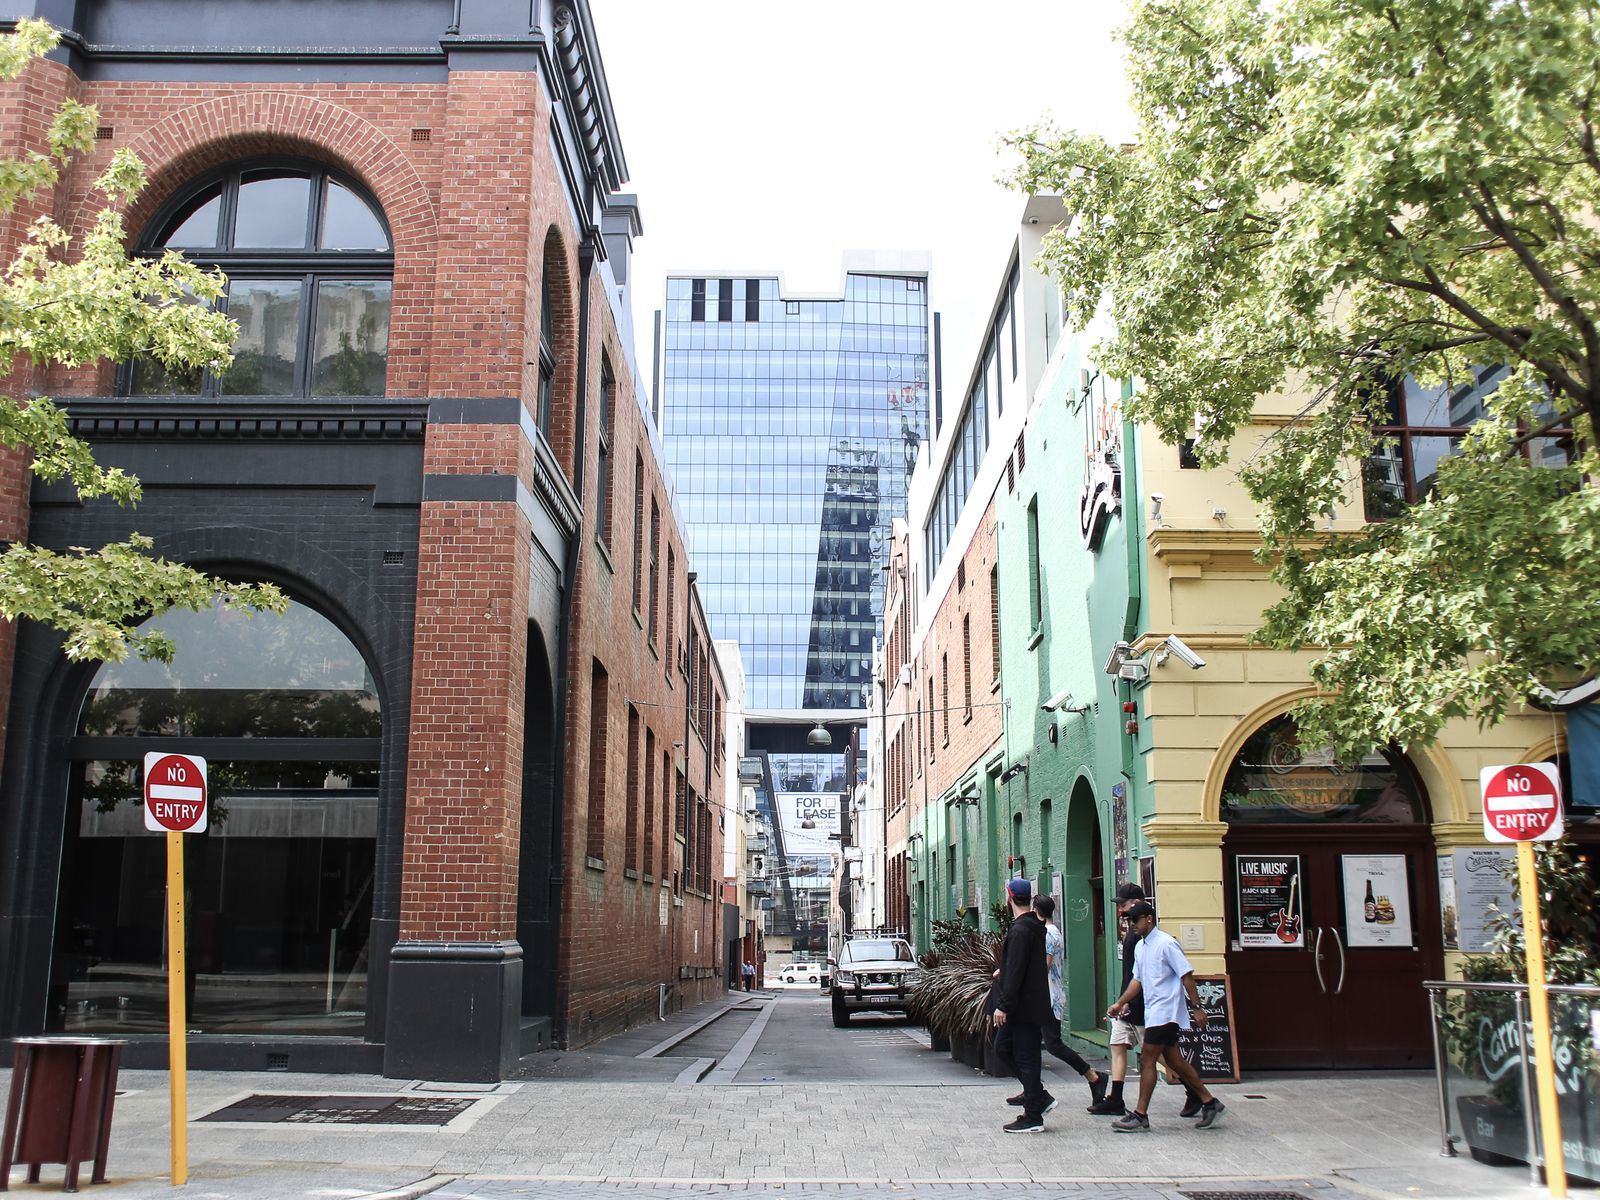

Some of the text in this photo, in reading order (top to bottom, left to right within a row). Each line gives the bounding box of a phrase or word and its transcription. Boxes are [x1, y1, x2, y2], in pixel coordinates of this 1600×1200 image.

[167, 767, 186, 782] NO
[1506, 777, 1531, 792] NO
[796, 797, 822, 808] FOR
[155, 802, 198, 819] ENTRY
[796, 808, 836, 819] LEASE
[1495, 812, 1549, 829] ENTRY
[1240, 862, 1288, 875] LIVE MUSIC
[1476, 1117, 1496, 1138] Bar
